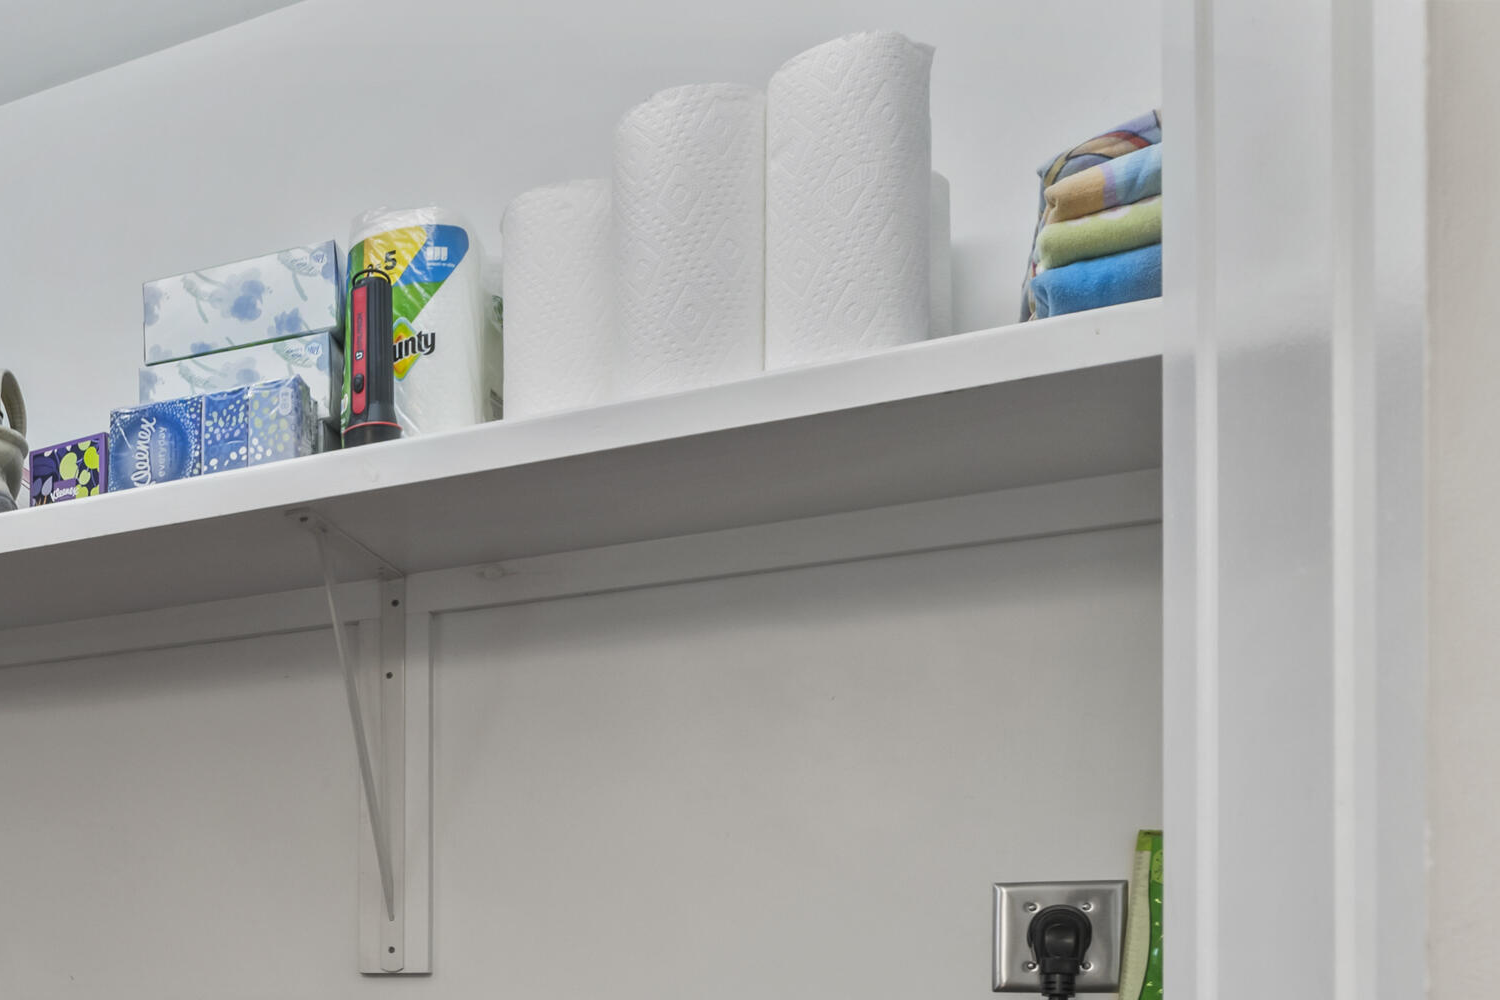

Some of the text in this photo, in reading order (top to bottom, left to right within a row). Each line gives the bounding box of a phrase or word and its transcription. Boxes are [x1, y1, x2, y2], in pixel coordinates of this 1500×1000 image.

[384, 250, 397, 271] 5
[393, 331, 437, 362] unty
[158, 427, 167, 477] everyday
[50, 485, 80, 502] Kleenex
